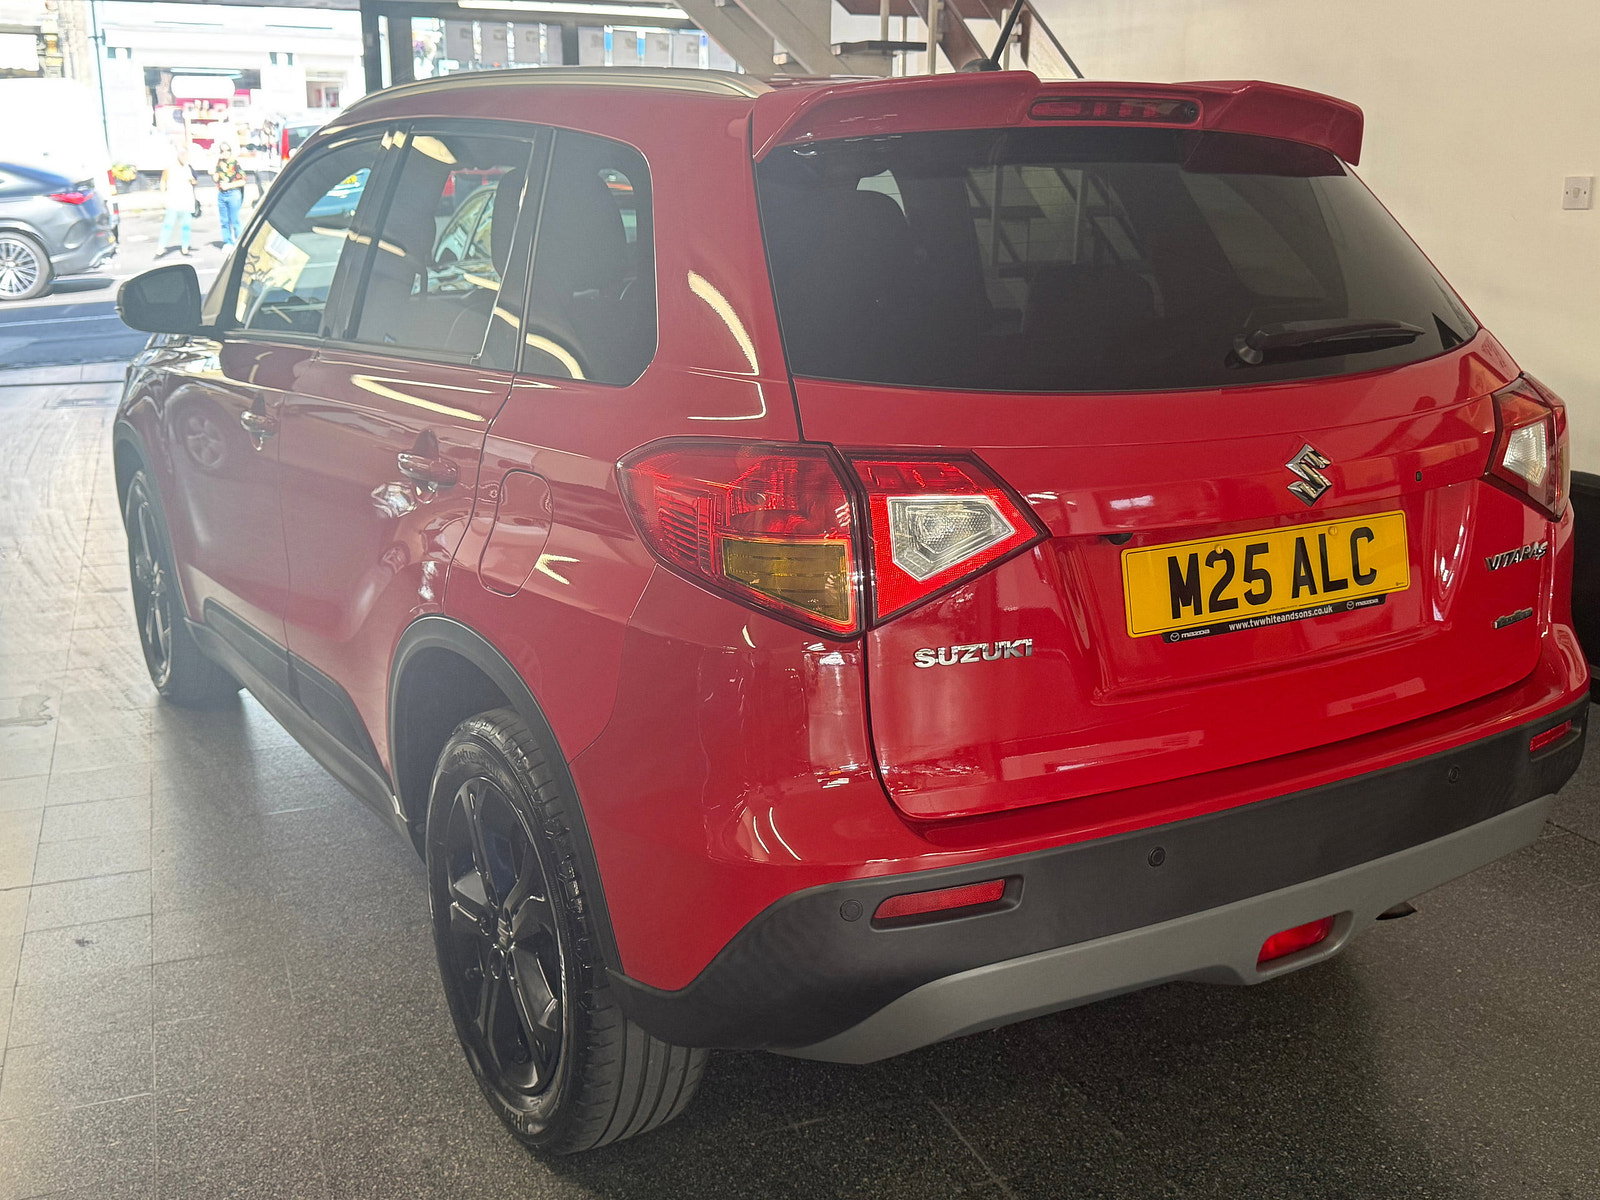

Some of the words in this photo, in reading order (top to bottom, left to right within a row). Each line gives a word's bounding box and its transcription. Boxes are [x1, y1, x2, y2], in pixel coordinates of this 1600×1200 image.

[1168, 542, 1272, 619] M25
[1292, 527, 1377, 599] ALC
[1181, 628, 1210, 639] mazda
[1228, 604, 1333, 631] www.twwhiteandsons.co.uk
[1355, 598, 1379, 607] mazda
[914, 639, 1033, 668] SUZUKI
